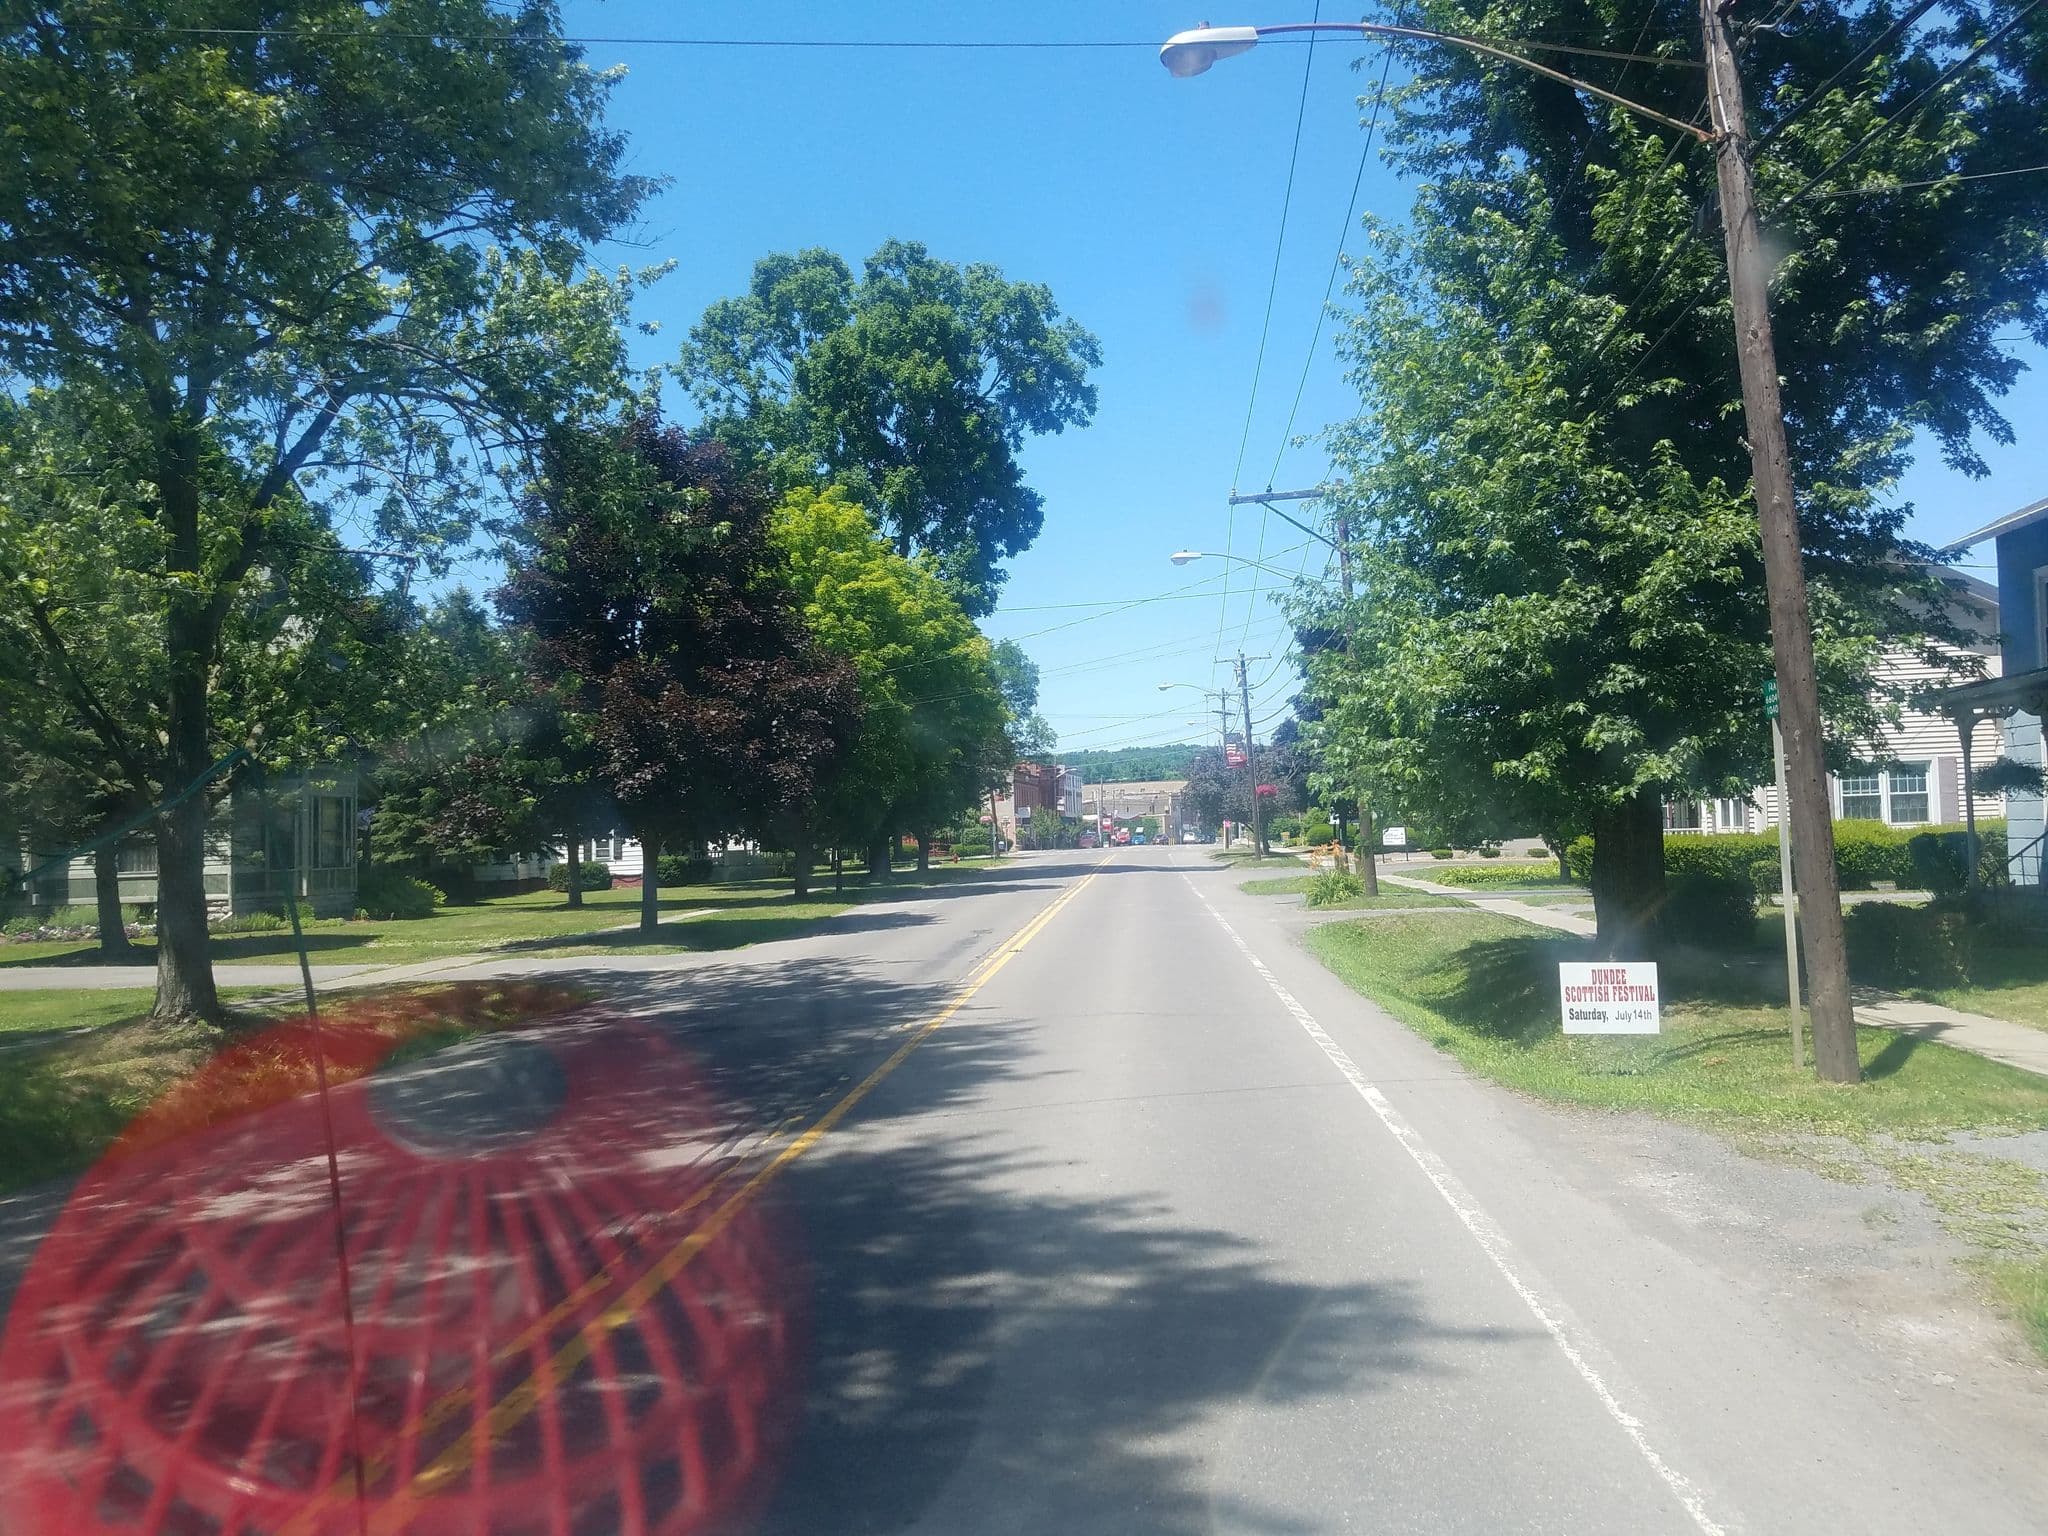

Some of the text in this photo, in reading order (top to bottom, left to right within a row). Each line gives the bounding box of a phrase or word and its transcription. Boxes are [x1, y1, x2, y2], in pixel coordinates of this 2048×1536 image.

[1591, 969, 1627, 985] DUNDEE
[1565, 985, 1655, 1003] SCOTTISH FESTIVAL
[1569, 1008, 1652, 1023] Saturday, July 14th
